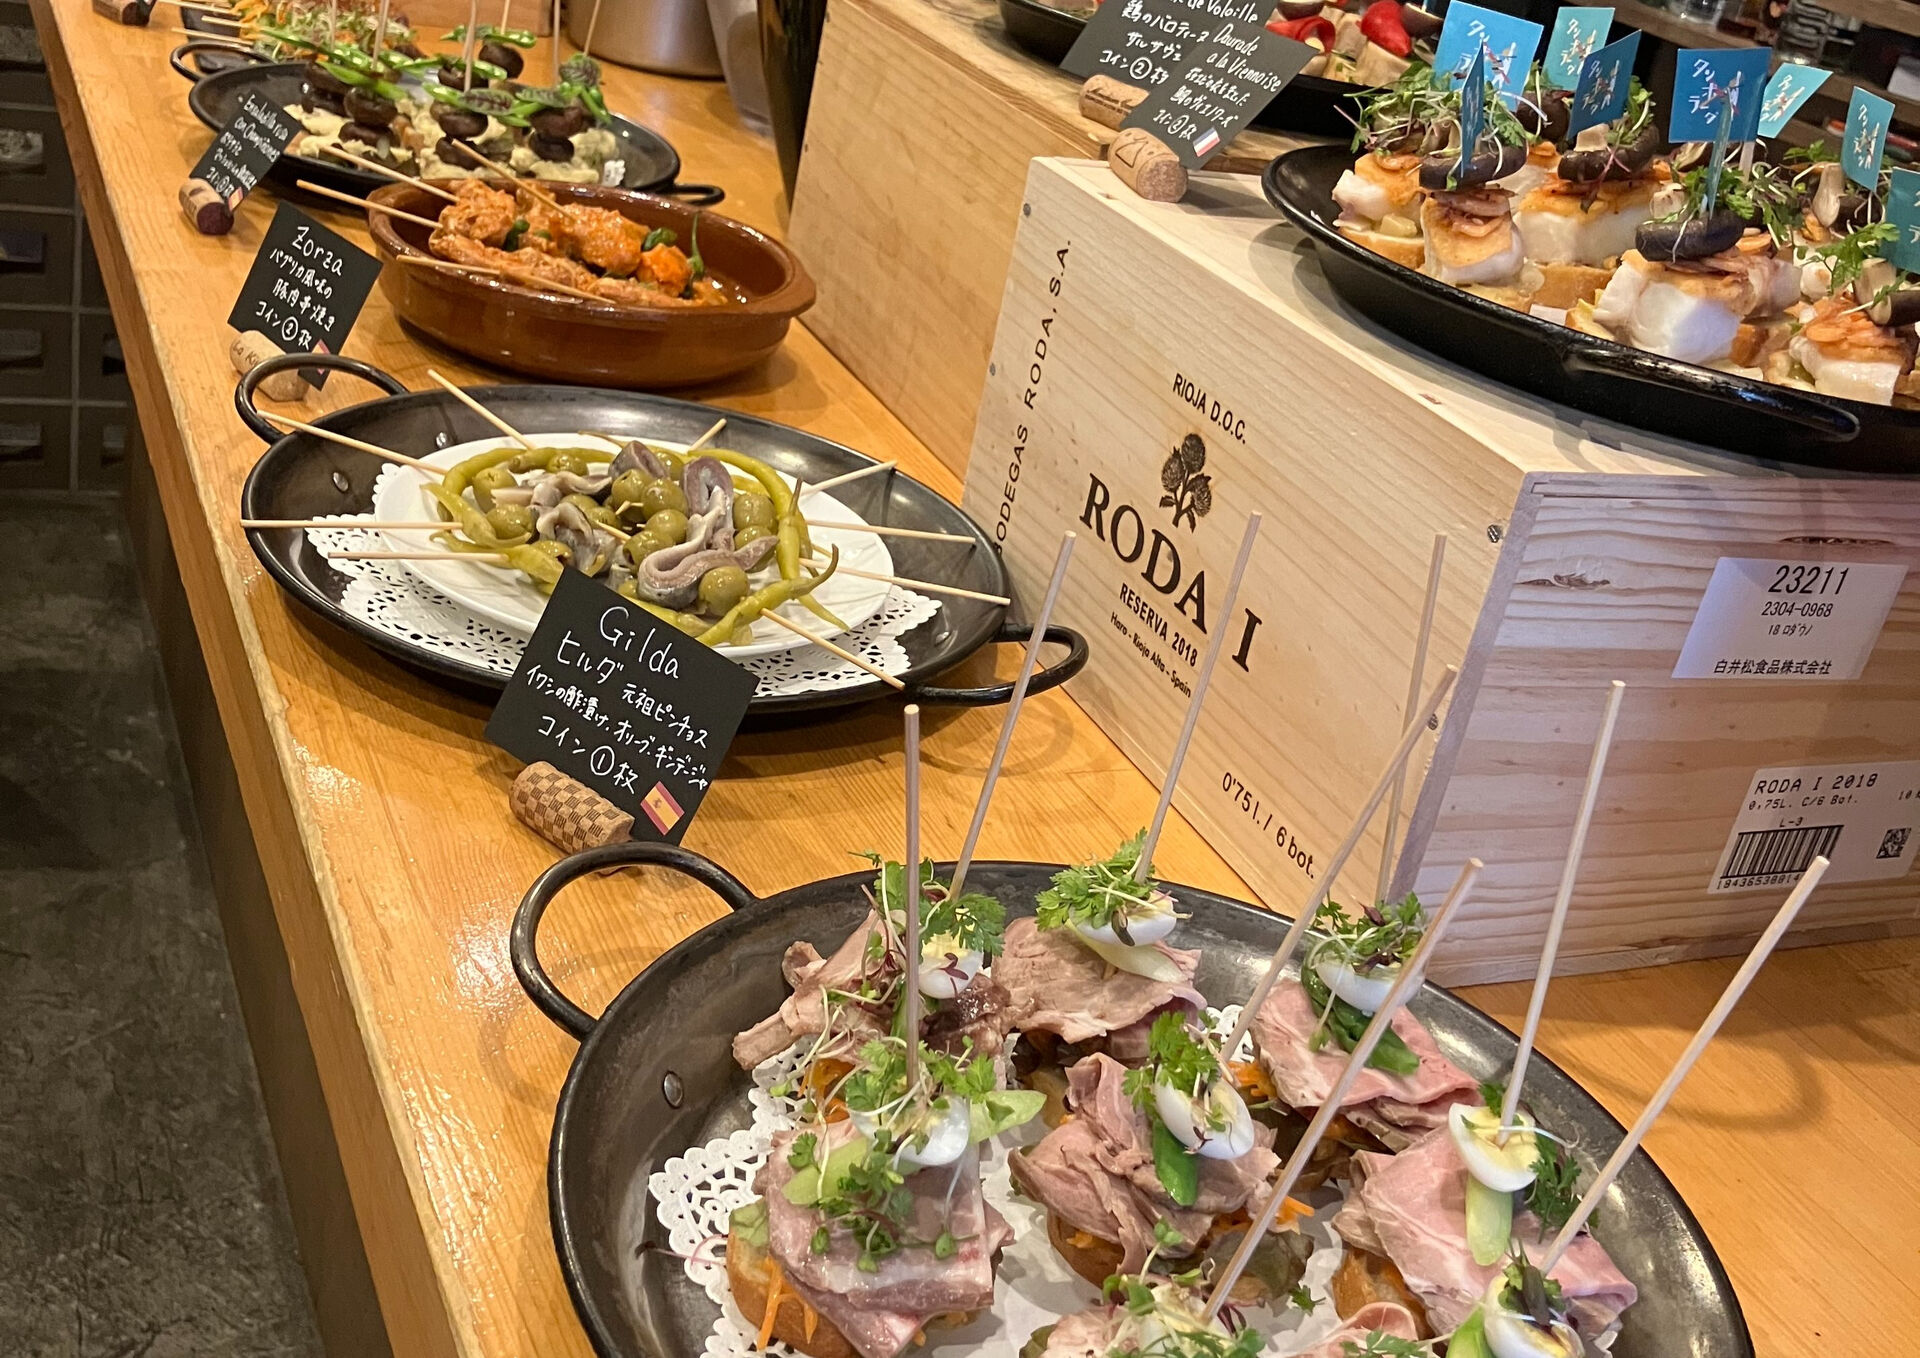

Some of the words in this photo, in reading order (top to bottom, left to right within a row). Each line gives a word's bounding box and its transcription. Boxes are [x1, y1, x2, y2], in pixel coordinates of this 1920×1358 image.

[292, 226, 343, 276] Zorza
[1172, 373, 1207, 415] RIOJA
[1210, 400, 1247, 445] D.O.C.
[1079, 472, 1207, 635] RODA
[1231, 607, 1262, 673] I
[1768, 564, 1850, 595] 23211
[1120, 582, 1168, 641] RESERVA
[1171, 632, 1198, 667] 2018
[1761, 601, 1834, 618] 2304-0968
[1768, 624, 1780, 636] 18
[600, 606, 679, 679] Gilda
[1132, 632, 1150, 658] Rioja
[1150, 651, 1165, 673] Alta
[1170, 670, 1191, 698] Spain
[557, 630, 624, 684] ヒルダ
[621, 683, 708, 749] 元祖ピンチョス
[1713, 658, 1832, 675] 白井松食品株式会社
[1754, 778, 1802, 795] RODA
[1812, 776, 1823, 791] I
[1832, 773, 1878, 790] 2018
[1801, 796, 1825, 807] C/6
[1830, 794, 1858, 806] Bot.
[1288, 836, 1314, 879] bot.
